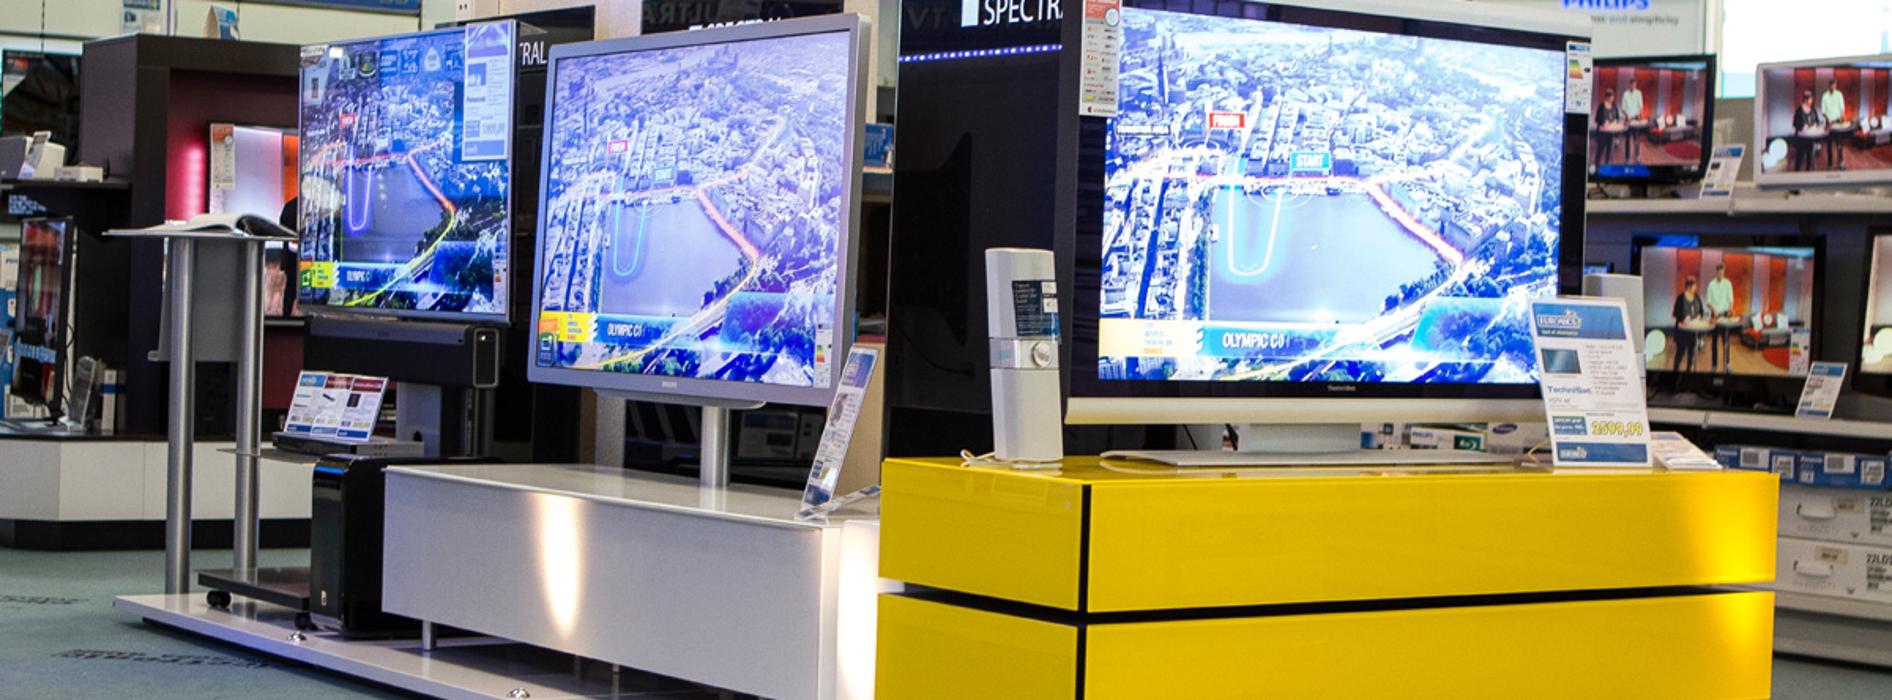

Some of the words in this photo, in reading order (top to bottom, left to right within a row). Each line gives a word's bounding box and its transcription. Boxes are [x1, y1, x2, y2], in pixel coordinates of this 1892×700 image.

[984, 0, 1063, 25] SPECTR
[1630, 15, 1678, 26] simplicity
[1297, 154, 1324, 169] START
[607, 323, 632, 337] OLYMPIC
[1223, 332, 1268, 349] OLYMPIC
[1548, 385, 1591, 394] TechniSat
